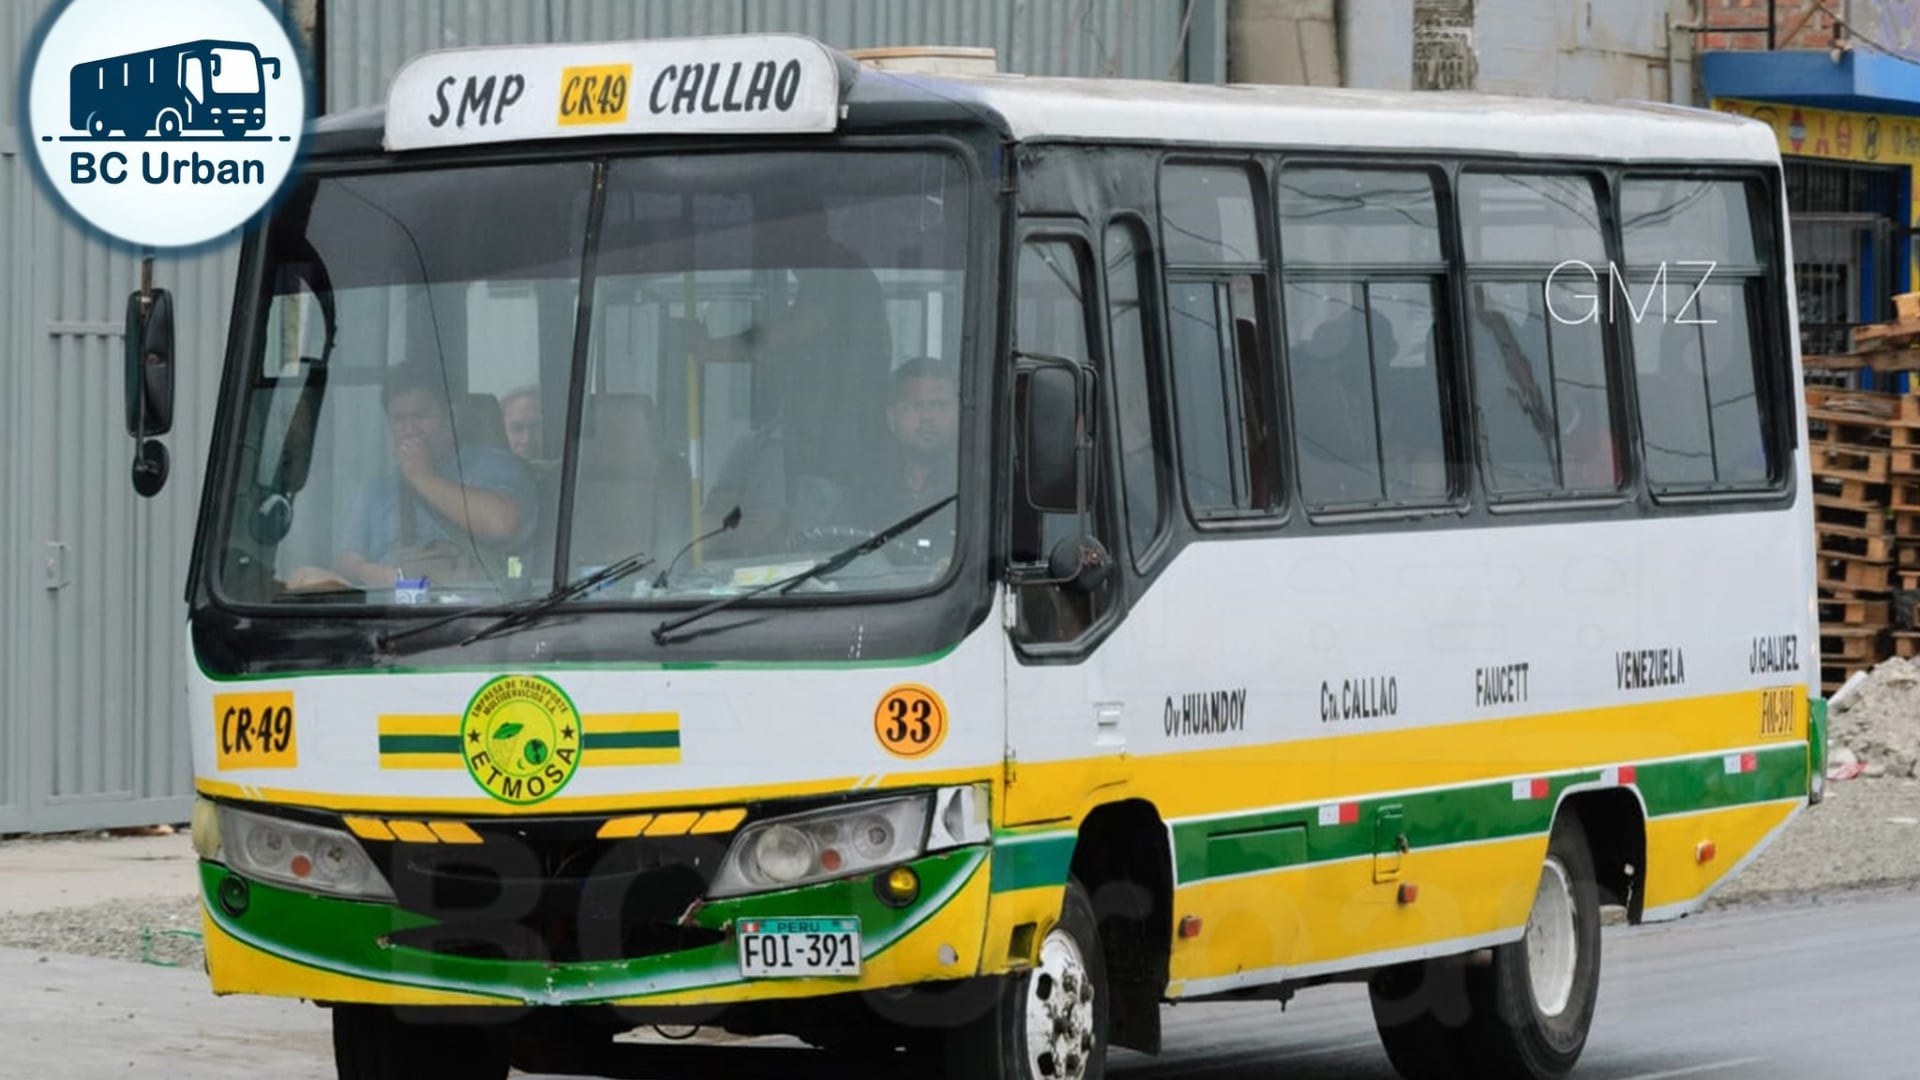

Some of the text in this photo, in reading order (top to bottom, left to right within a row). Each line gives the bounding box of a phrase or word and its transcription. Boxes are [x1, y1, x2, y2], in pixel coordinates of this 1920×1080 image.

[428, 73, 526, 129] SMP
[649, 58, 802, 114] CALLAO
[1475, 662, 1529, 707] FAUCETT
[1615, 647, 1685, 690] VENEZUELA
[1182, 688, 1247, 735] HUANDOY
[1343, 675, 1398, 720] CALLAO
[886, 698, 931, 743] 33
[471, 748, 575, 799] ETMOSA
[777, 922, 820, 932] PERU
[744, 933, 856, 968] FOI-391
